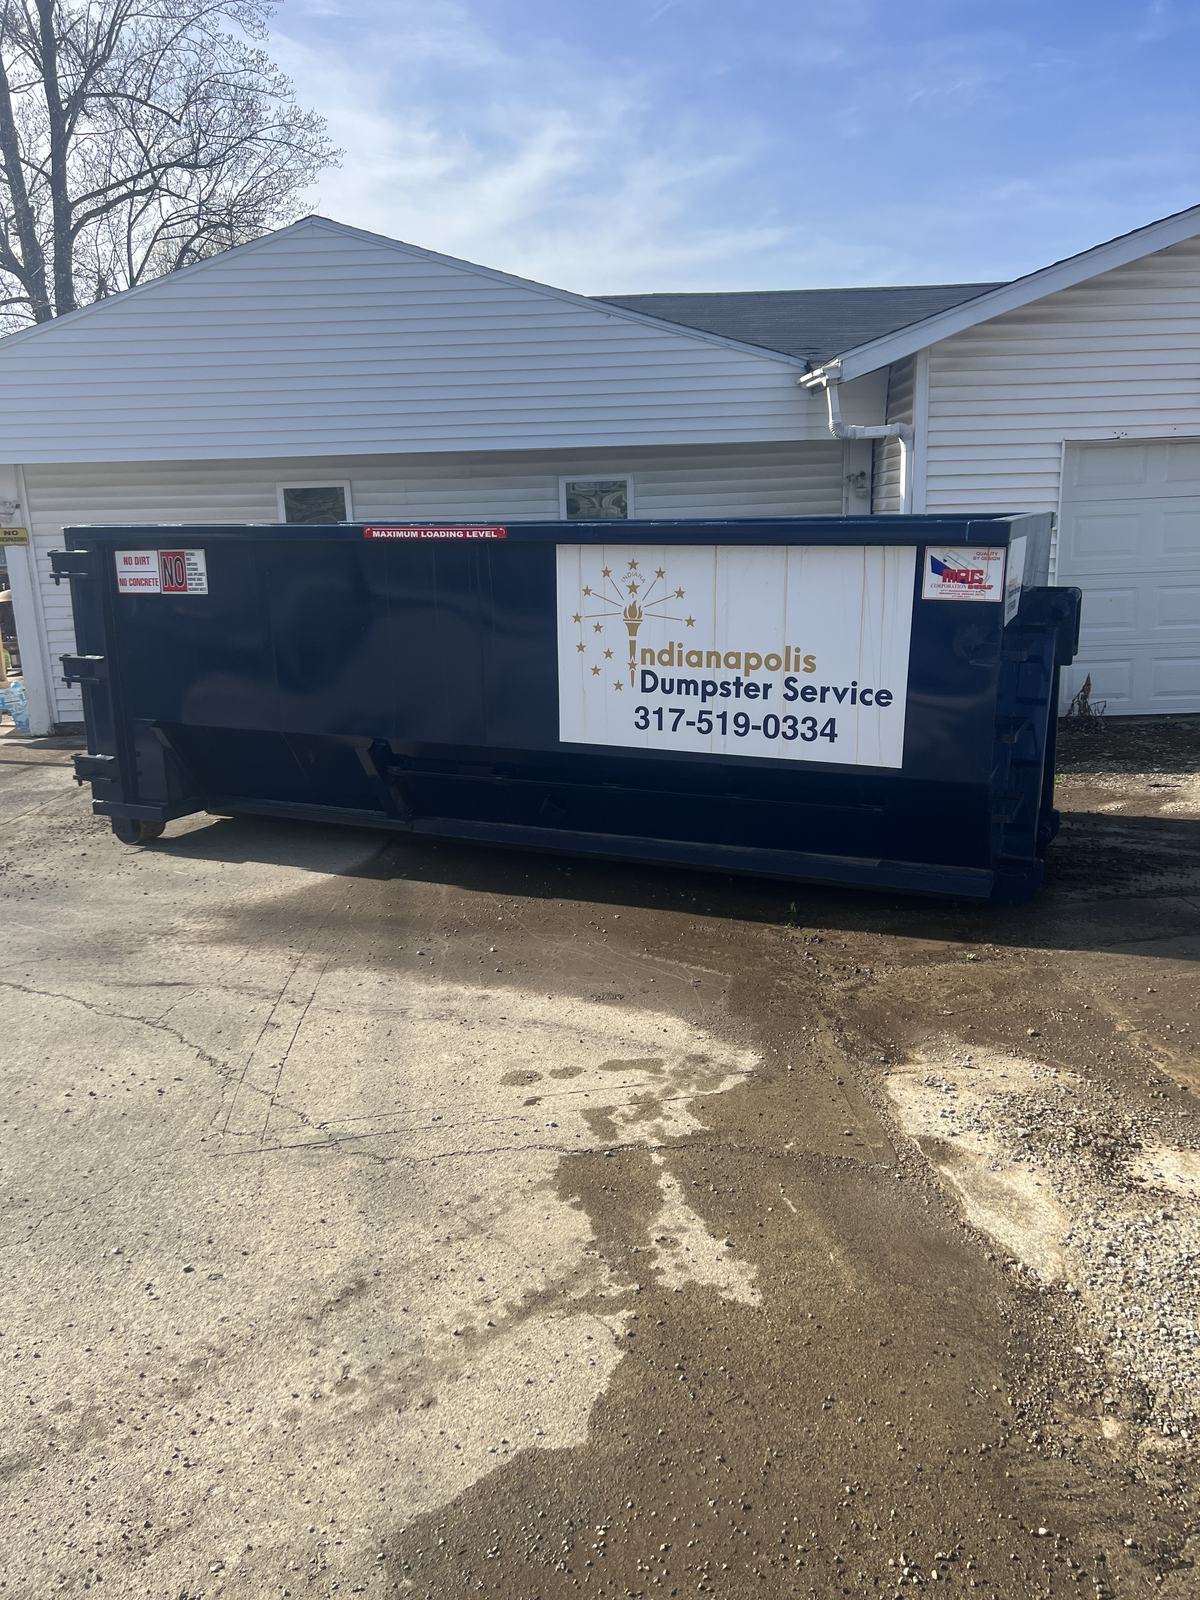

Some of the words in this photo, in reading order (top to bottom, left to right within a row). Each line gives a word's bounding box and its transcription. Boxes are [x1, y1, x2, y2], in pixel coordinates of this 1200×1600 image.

[372, 530, 419, 538] MAXIMUM
[420, 530, 464, 538] LOADING
[123, 556, 133, 566] NO
[134, 556, 150, 566] DIRT
[162, 555, 186, 588] NO
[620, 571, 646, 584] INDIANA
[119, 577, 128, 587] NO
[128, 577, 160, 587] CONCRETE
[640, 669, 773, 703] Dumpster
[783, 676, 894, 708] Service
[634, 705, 838, 743] 317-519-0334
